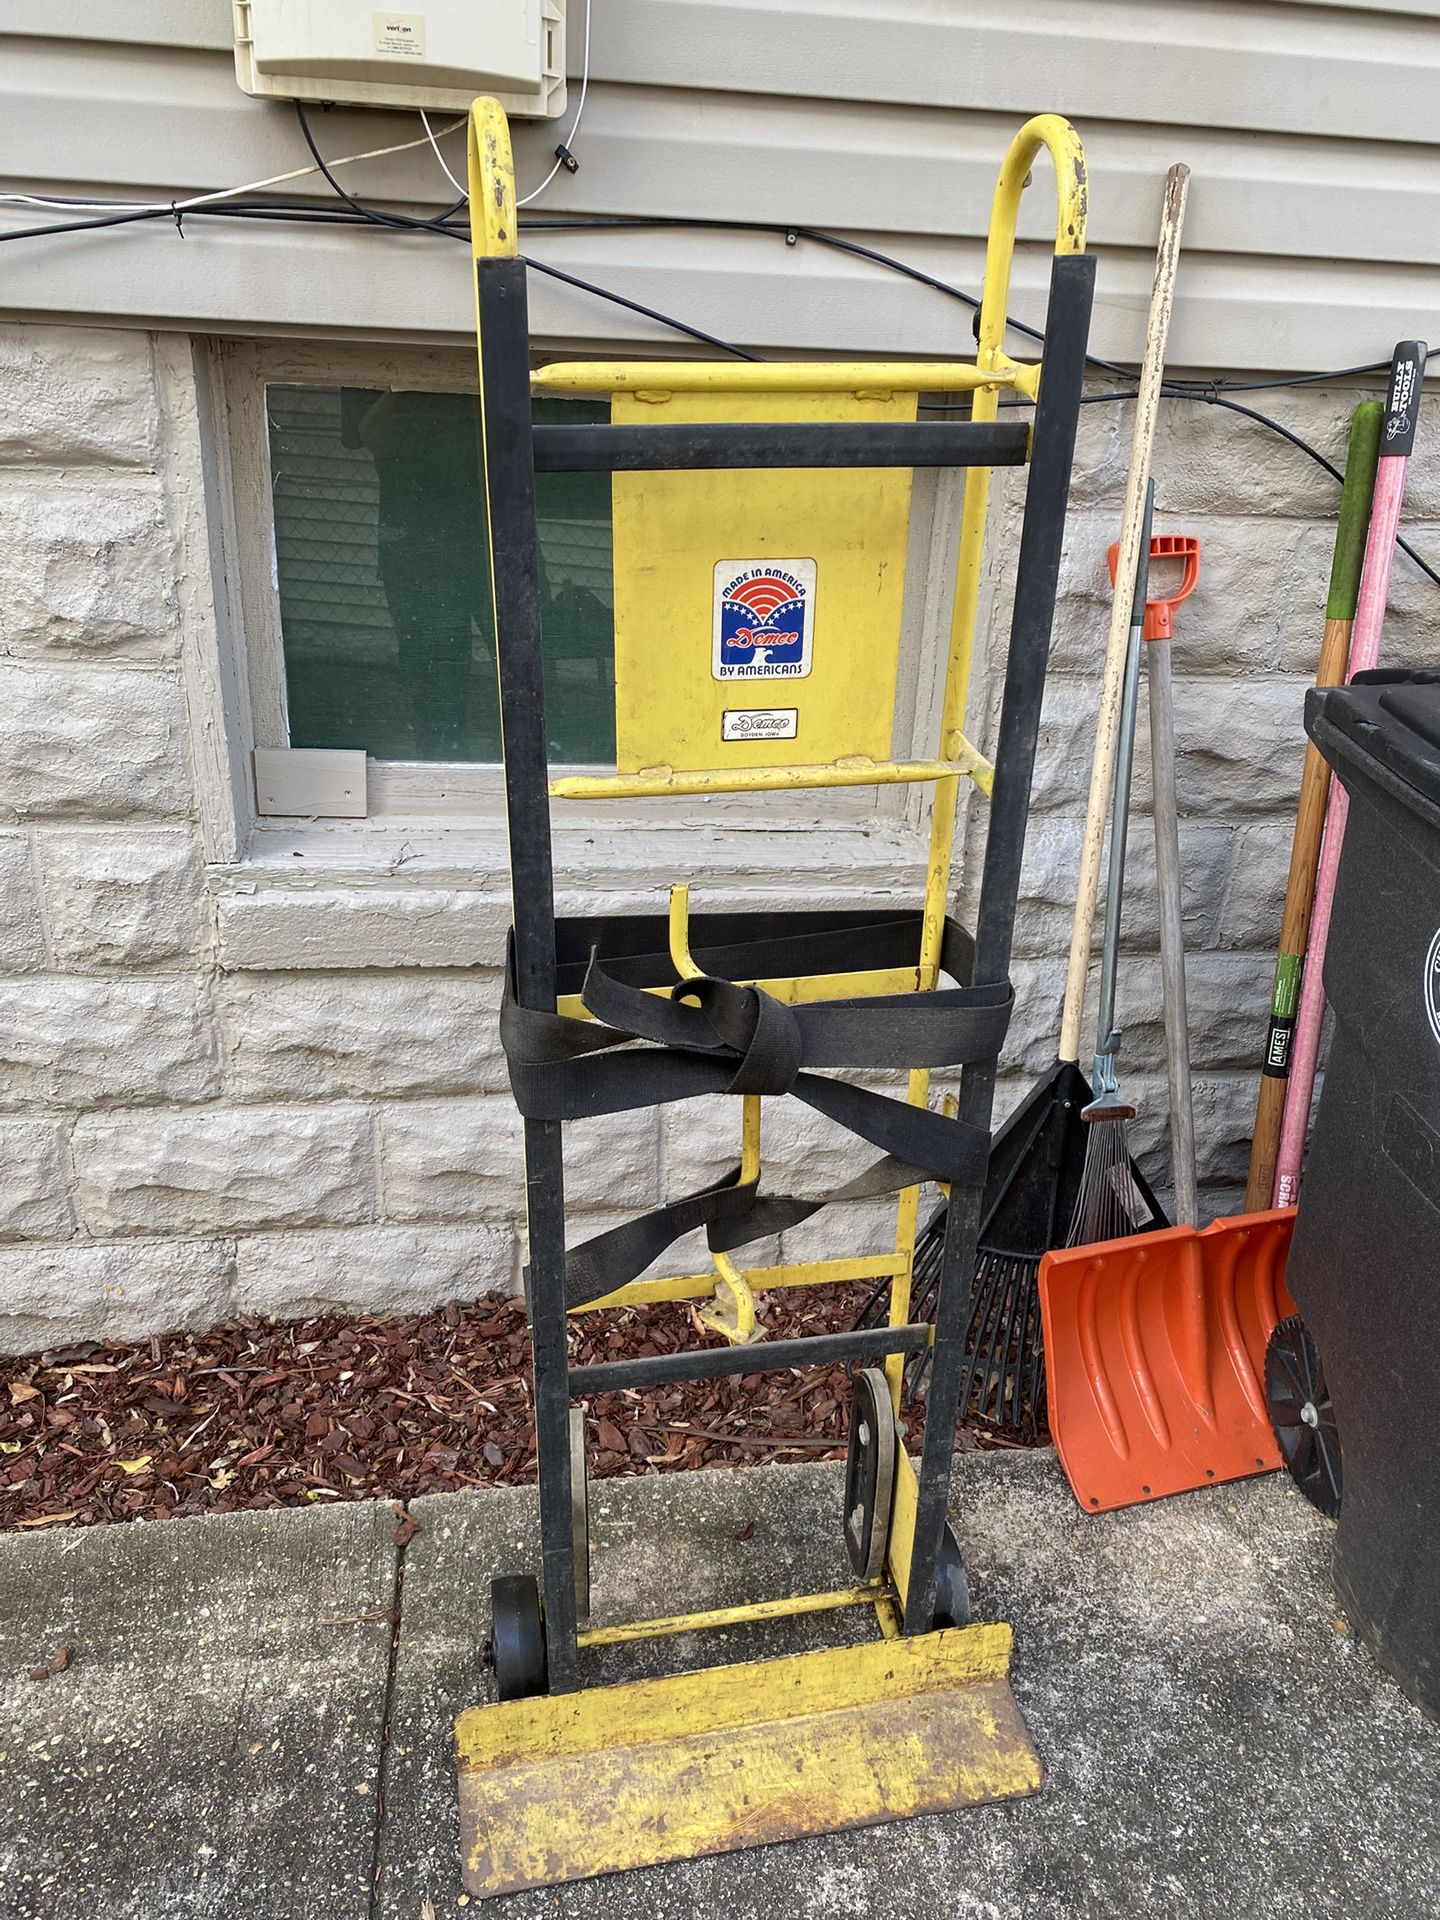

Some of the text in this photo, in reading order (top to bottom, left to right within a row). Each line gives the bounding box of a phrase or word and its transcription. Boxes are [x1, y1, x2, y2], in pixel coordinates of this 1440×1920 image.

[386, 24, 412, 33] verizon
[1391, 361, 1405, 412] BULLY
[1399, 360, 1413, 412] TOOLS
[722, 568, 807, 599] MADE IN AMERICA
[727, 627, 799, 647] Demco
[720, 664, 803, 676] BY AMERICANS
[731, 714, 790, 732] Demco
[1271, 1031, 1287, 1063] AMES
